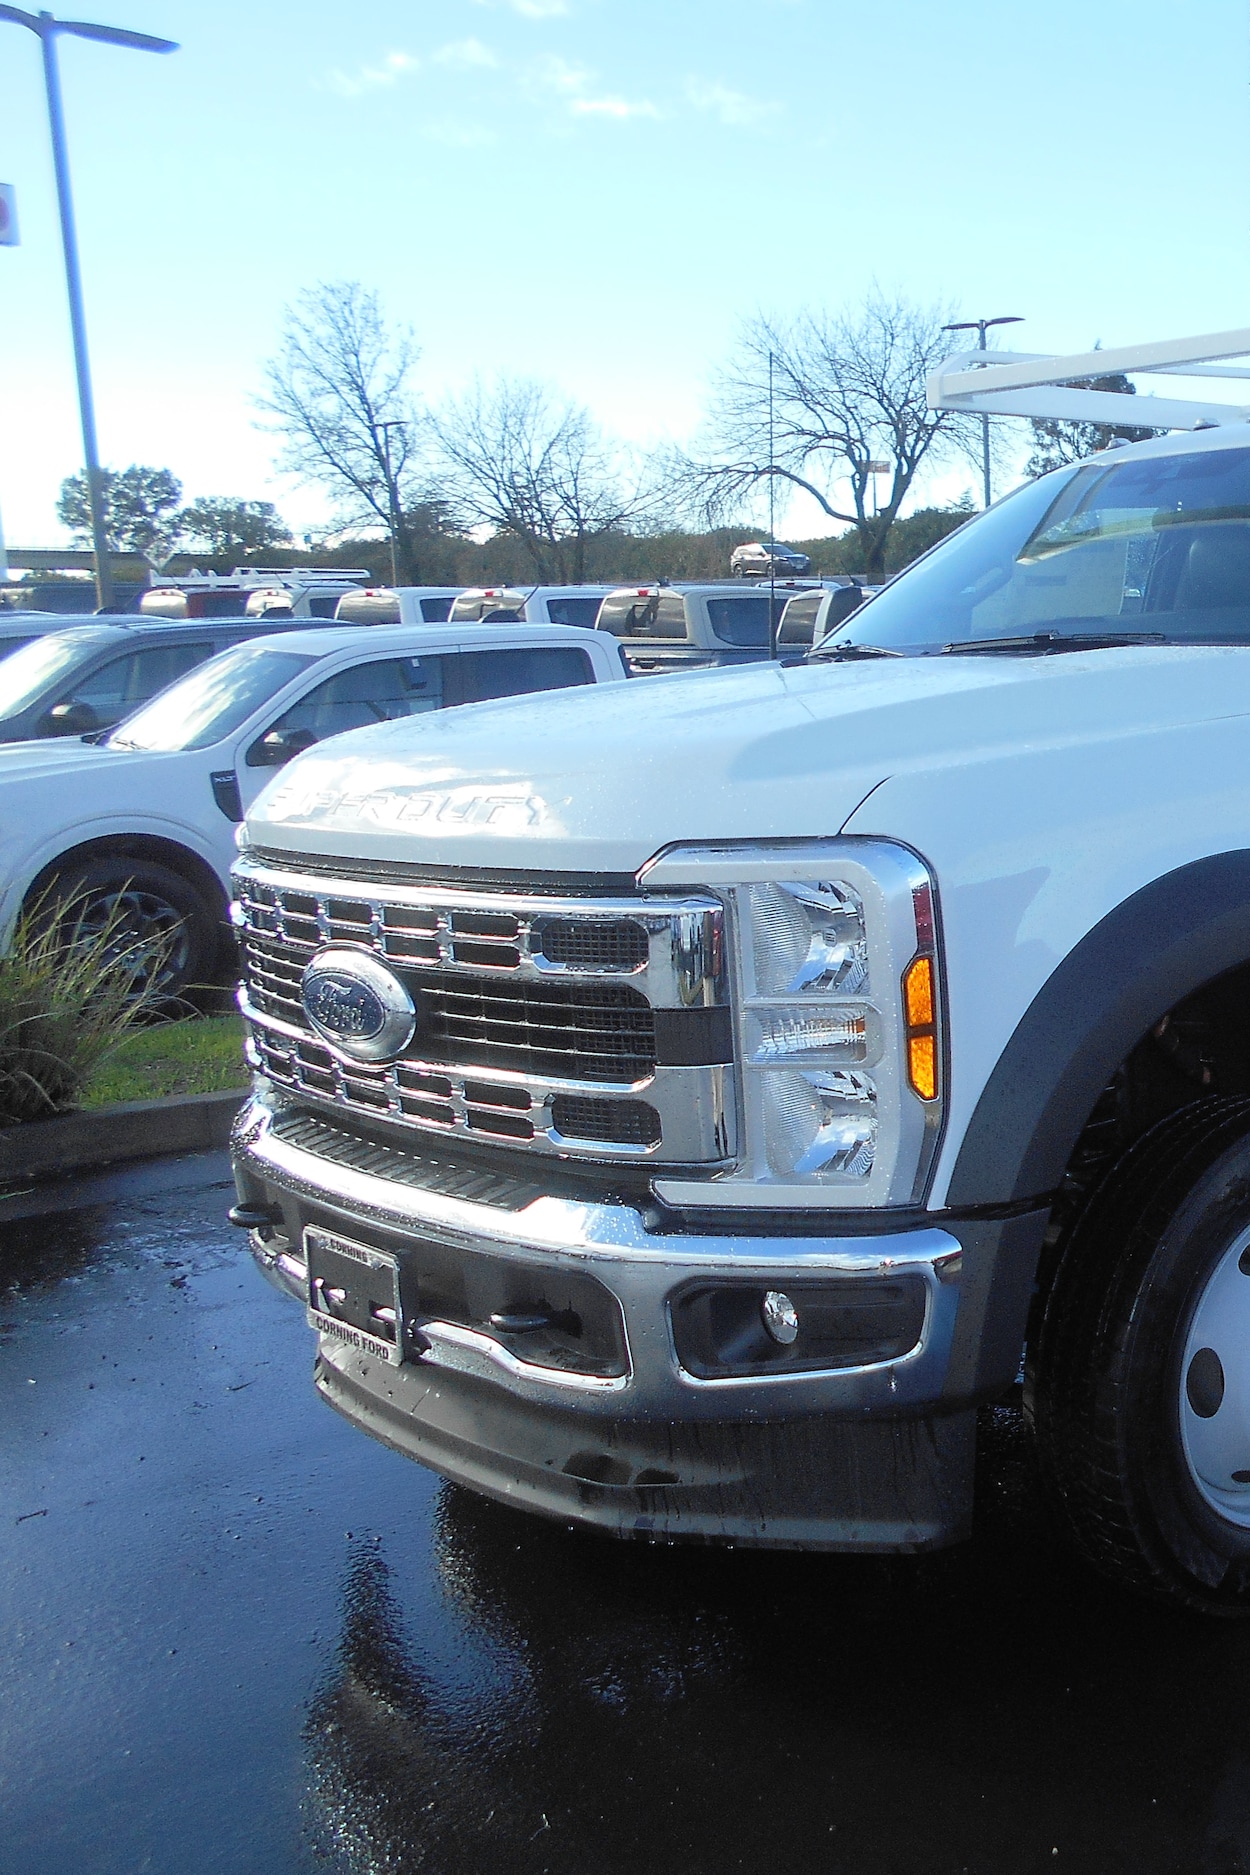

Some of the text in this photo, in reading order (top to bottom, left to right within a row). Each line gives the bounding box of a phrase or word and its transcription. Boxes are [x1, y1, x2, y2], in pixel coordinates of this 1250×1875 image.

[397, 793, 573, 826] DUTY
[318, 980, 367, 1031] Ford
[329, 1238, 369, 1263] CORNING
[315, 1316, 390, 1360] CORNING FORD
